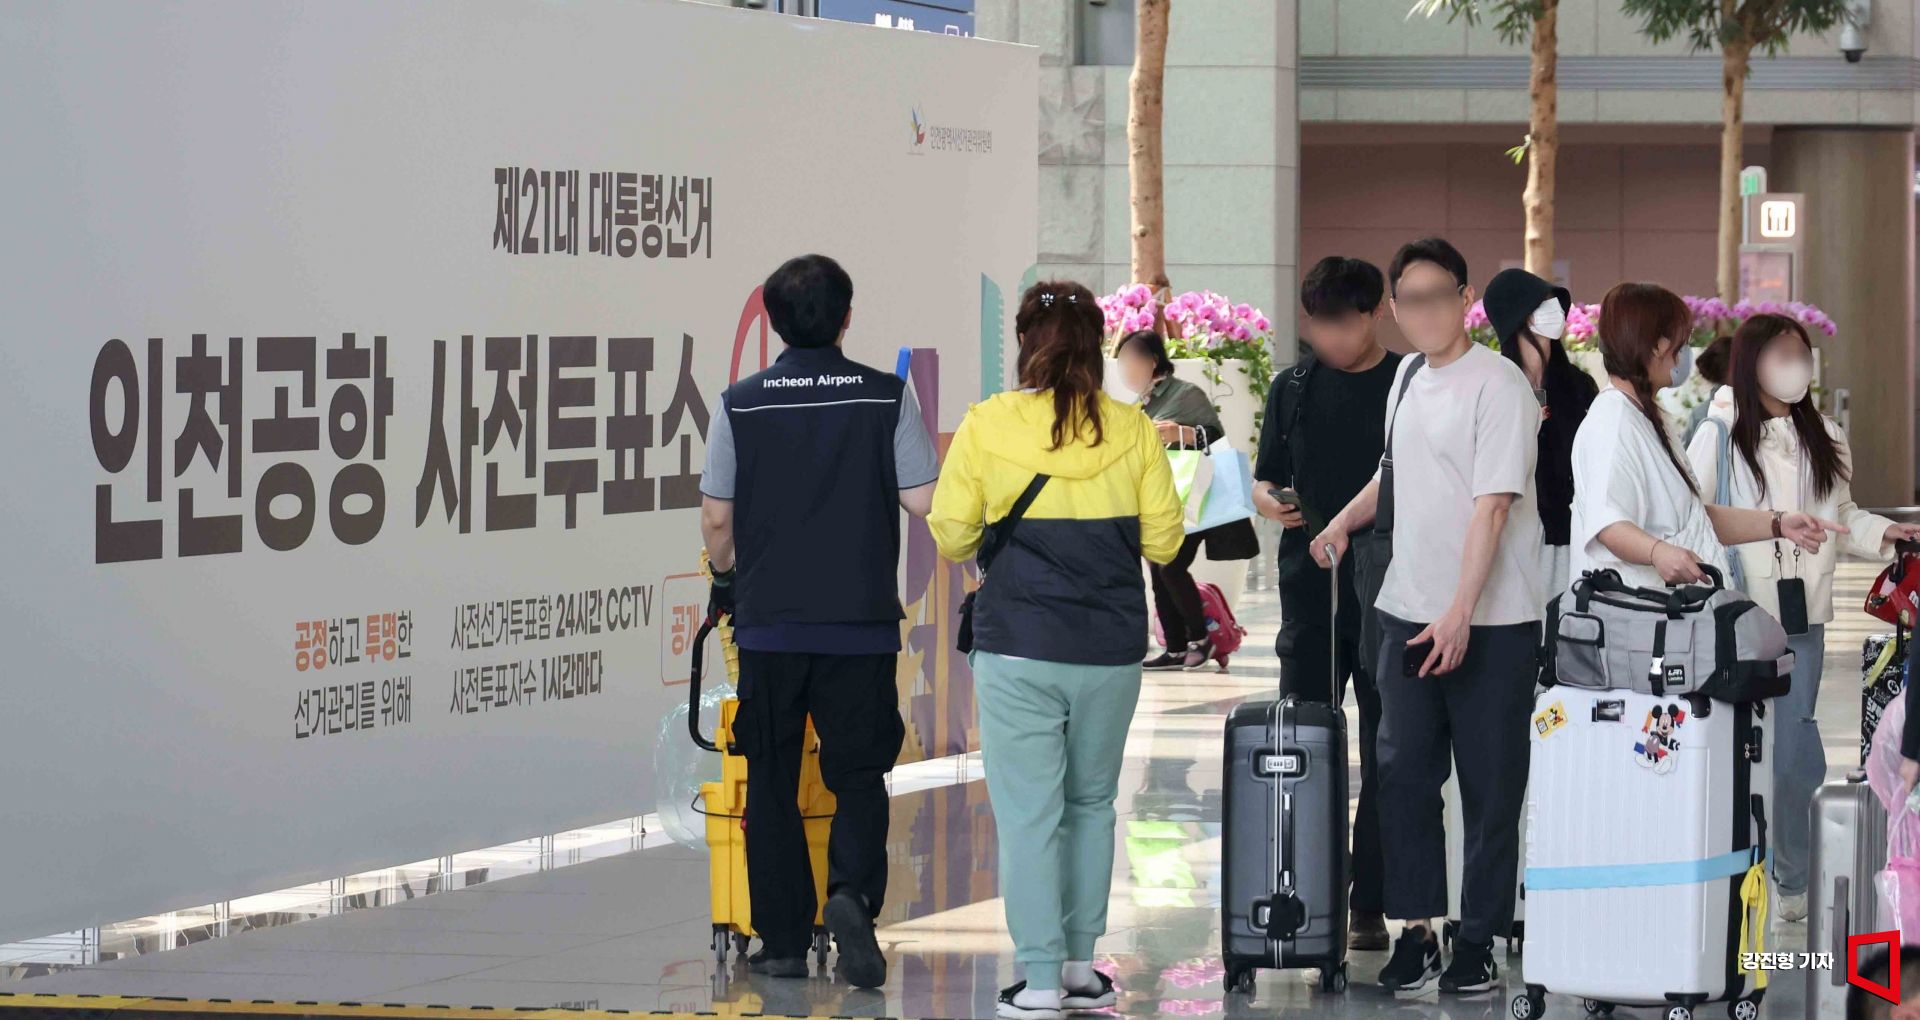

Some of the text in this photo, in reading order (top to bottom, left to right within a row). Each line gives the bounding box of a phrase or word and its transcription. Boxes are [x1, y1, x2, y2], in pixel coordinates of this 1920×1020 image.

[493, 166, 713, 259] 제21대 대통령선거
[763, 374, 863, 388] Incheon Airport
[89, 332, 710, 564] 인천공항 사전투표소
[295, 609, 413, 672] 공정하고 투명한
[450, 584, 653, 651] 사전선거투표함 24시간 CCTV
[671, 603, 701, 656] 공개
[294, 675, 411, 739] 선거관리를 위해
[450, 650, 603, 715] 사전투표자수 1시간마다
